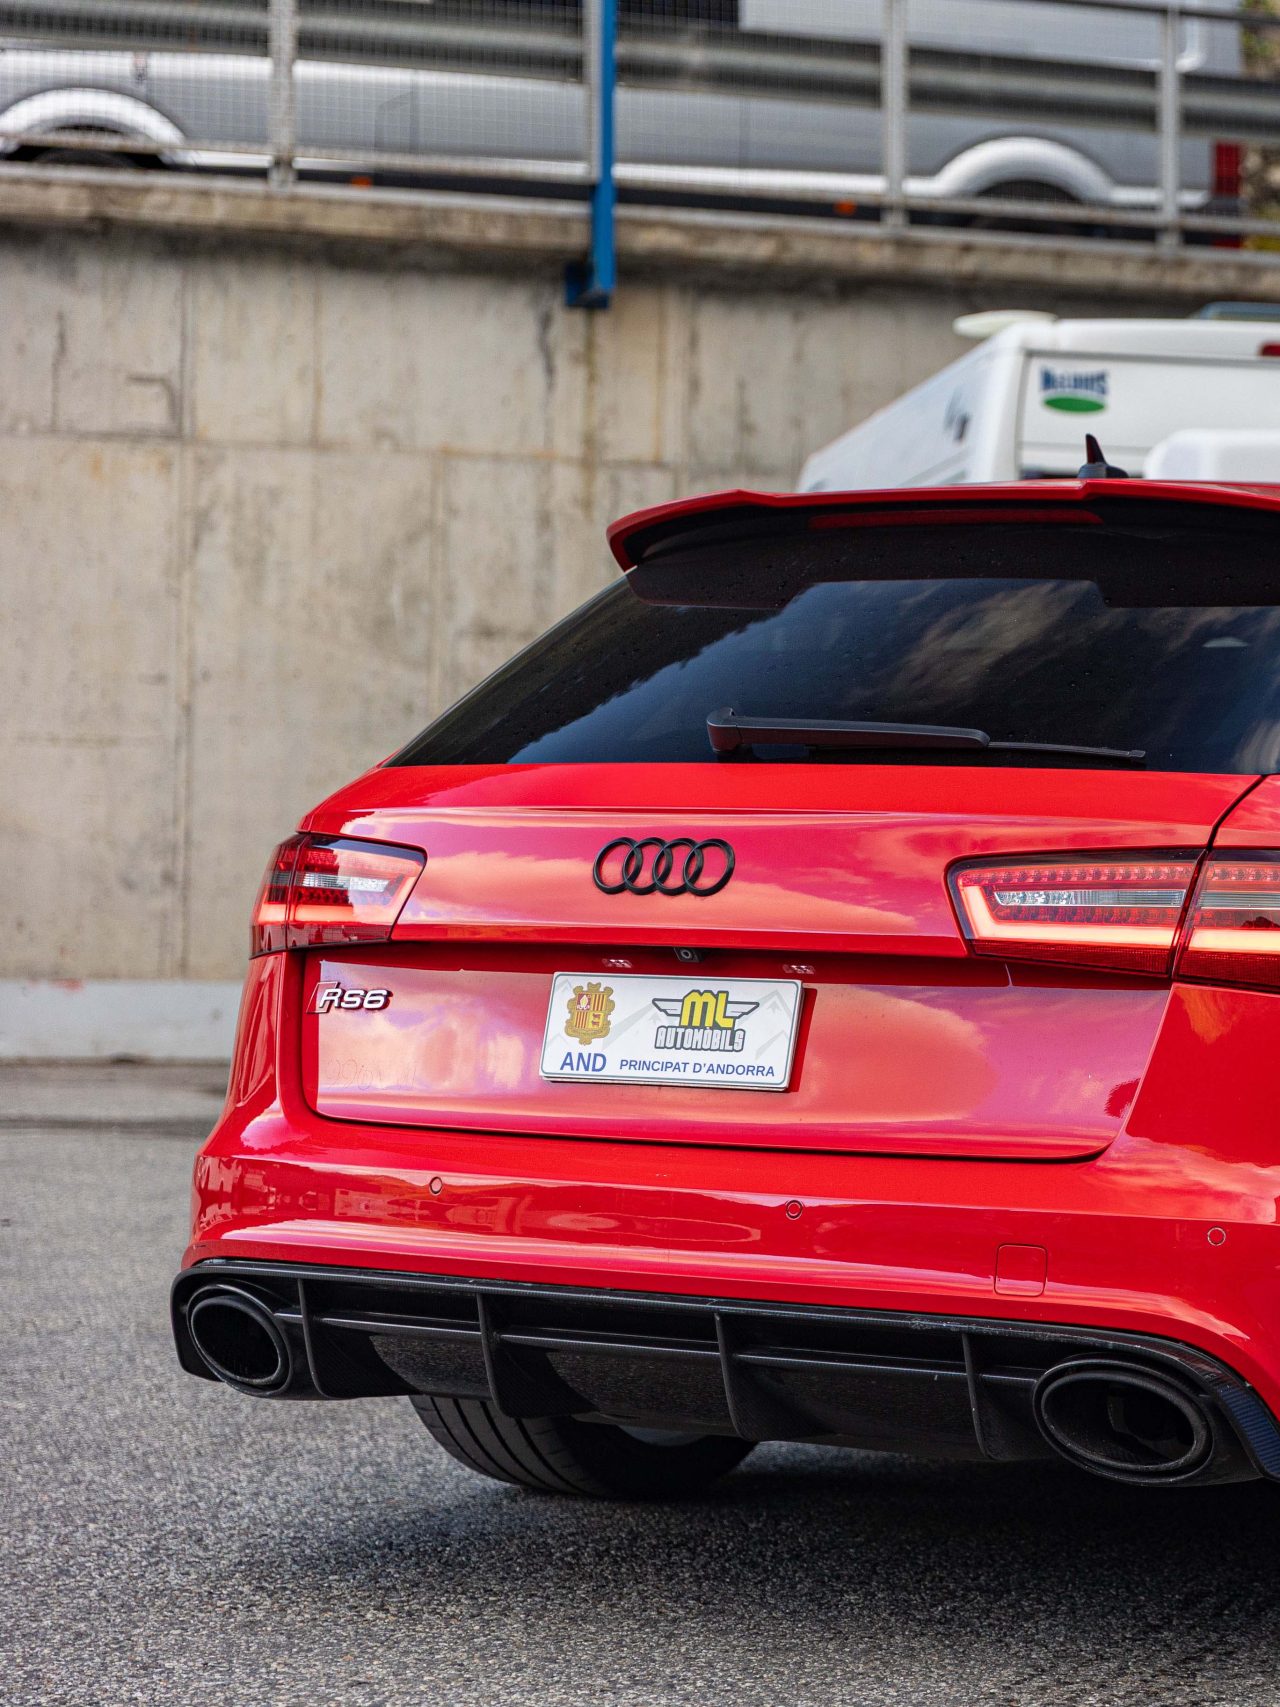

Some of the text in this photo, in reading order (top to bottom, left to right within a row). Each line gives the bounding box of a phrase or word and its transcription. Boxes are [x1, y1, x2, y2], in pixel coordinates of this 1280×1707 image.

[318, 988, 391, 1010] RS6
[680, 989, 736, 1028] ML
[560, 1051, 607, 1072] AND
[619, 1059, 775, 1077] PRINCIPAT D'ANDORRA
